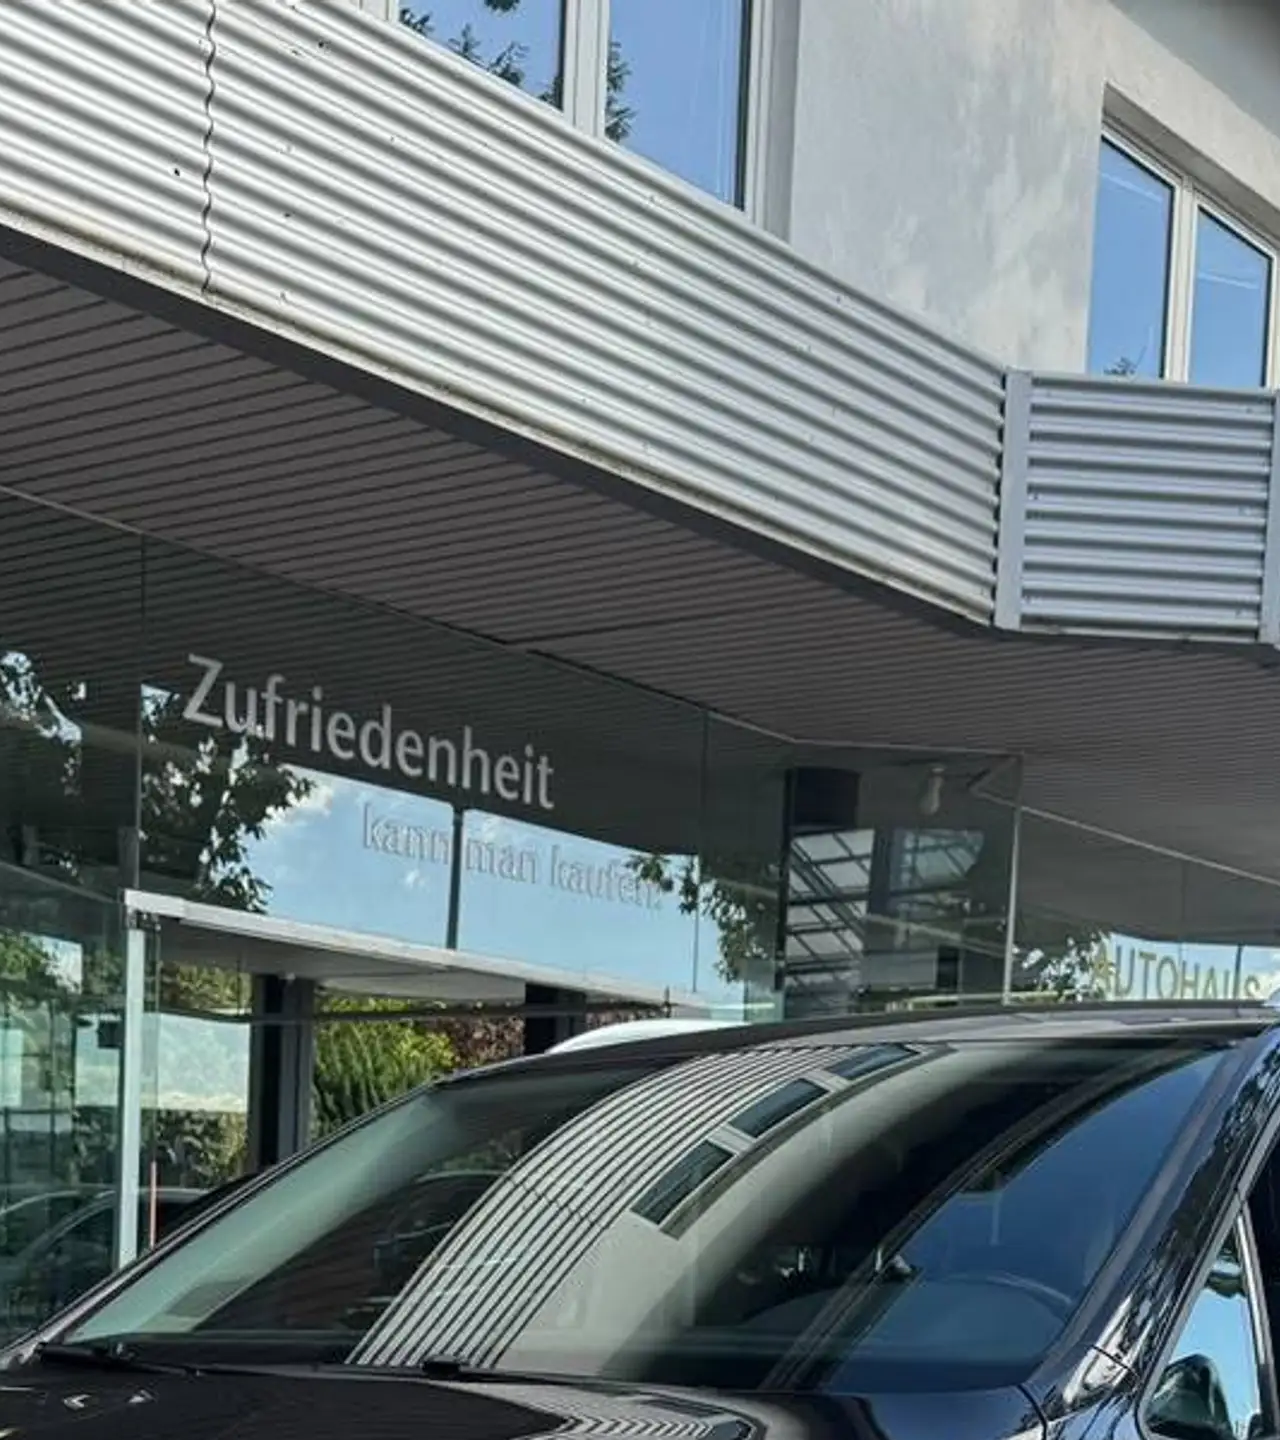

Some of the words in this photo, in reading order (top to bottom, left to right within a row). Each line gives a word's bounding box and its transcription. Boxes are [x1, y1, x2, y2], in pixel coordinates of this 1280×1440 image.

[182, 653, 555, 810] Zufriedenheit
[362, 802, 450, 866] kann
[465, 838, 538, 884] man
